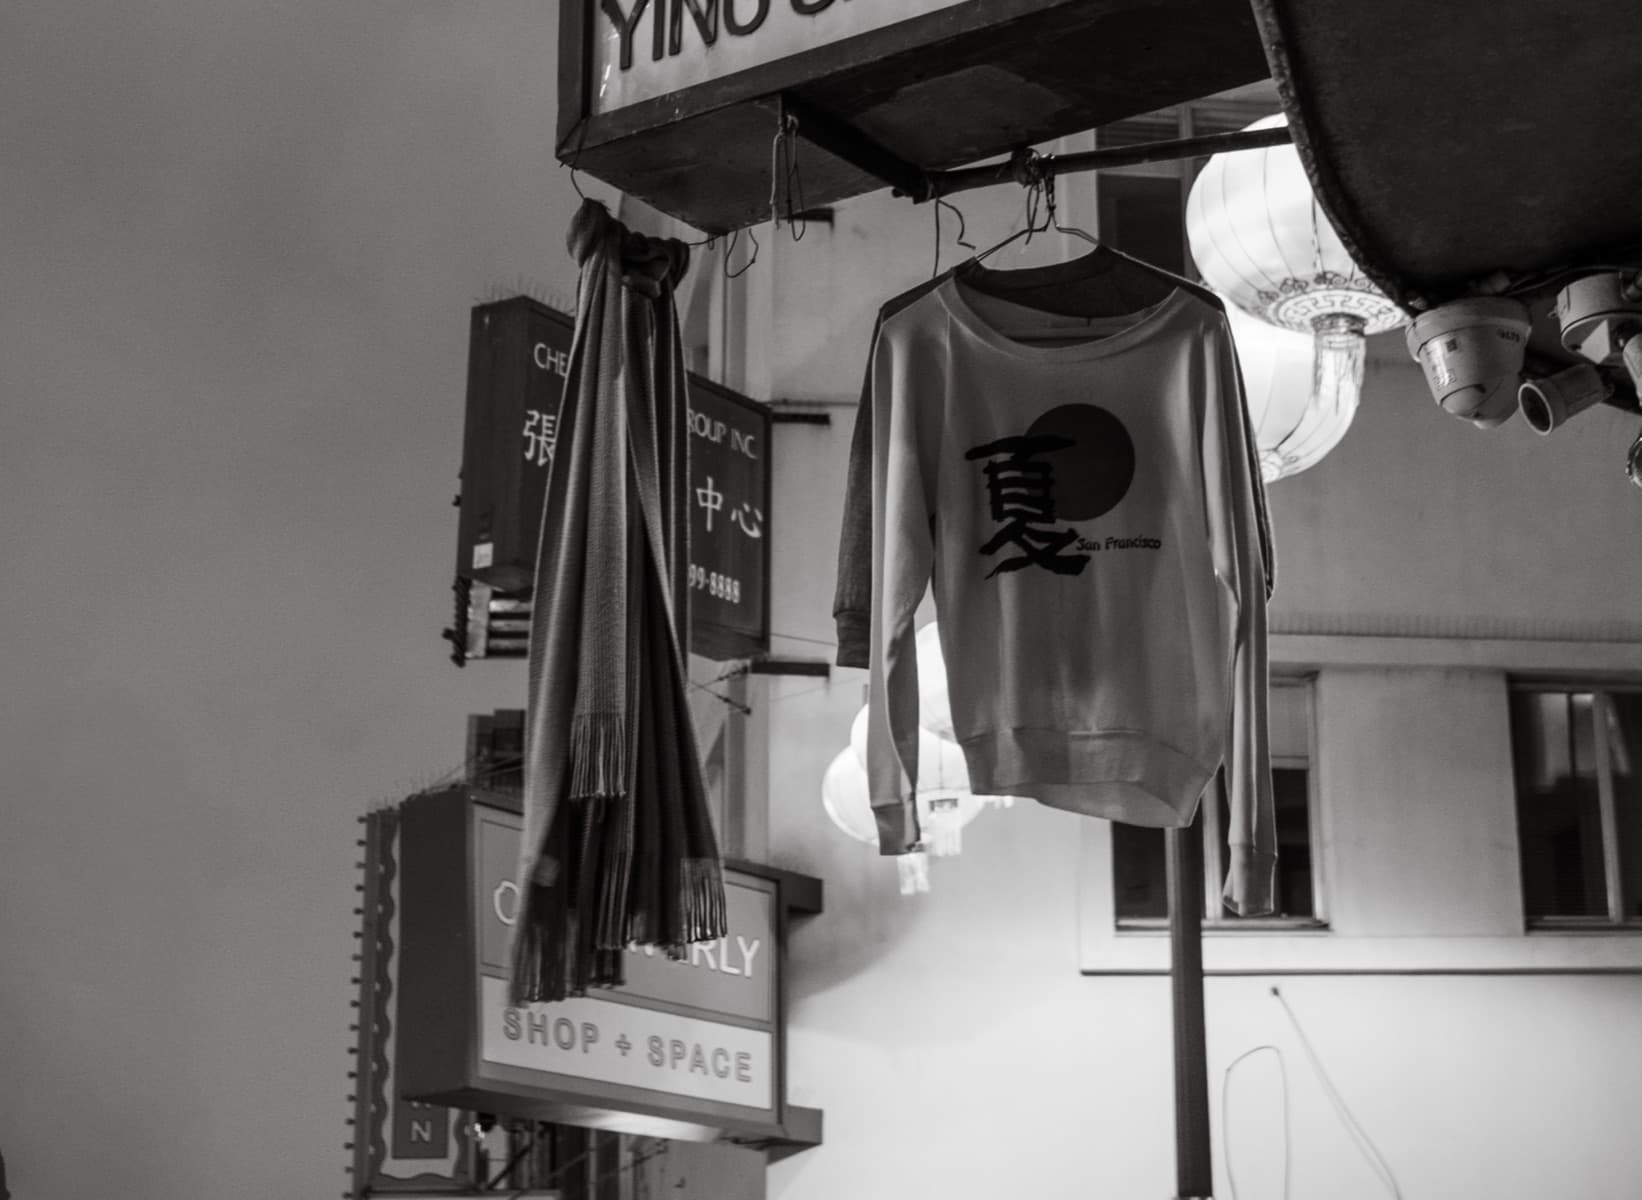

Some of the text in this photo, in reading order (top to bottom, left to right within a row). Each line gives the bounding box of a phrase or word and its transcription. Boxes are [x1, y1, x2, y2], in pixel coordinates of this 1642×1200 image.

[731, 428, 758, 459] INC
[696, 475, 763, 538] 中心
[1076, 536, 1162, 551] San Francisco
[503, 1005, 599, 1054] SHOP
[647, 1035, 752, 1084] SPACE
